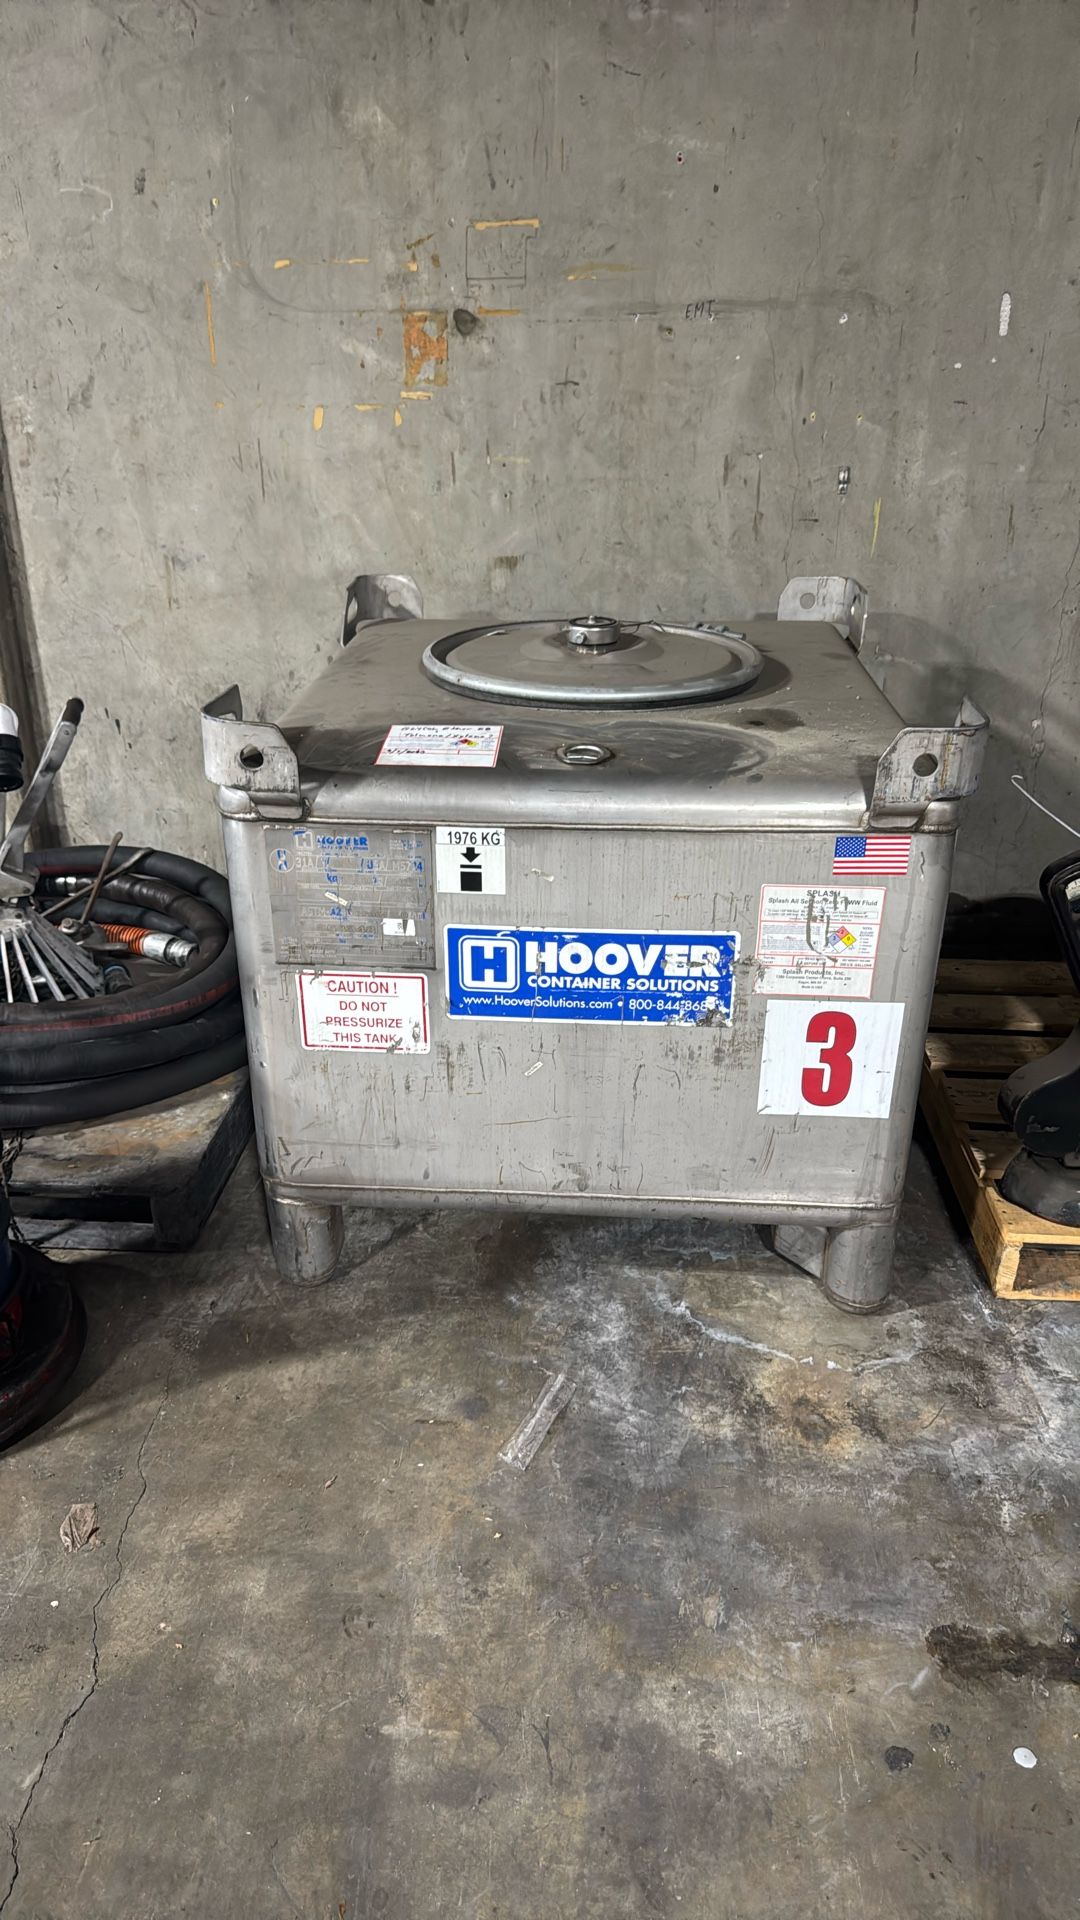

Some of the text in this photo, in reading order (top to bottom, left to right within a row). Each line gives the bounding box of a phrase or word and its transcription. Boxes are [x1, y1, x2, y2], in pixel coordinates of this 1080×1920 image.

[448, 831, 500, 846] 1976 KG
[768, 897, 788, 905] Splash
[525, 941, 721, 977] HOOVER
[327, 980, 389, 994] CAUTION
[527, 975, 719, 992] CONTAINER SOLUTIONS
[339, 1001, 388, 1012] DO NOT
[463, 995, 613, 1009] www.HooverSolutions.com
[325, 1016, 403, 1028] PRESSURIZE
[333, 1032, 398, 1043] THIS TANK
[801, 1011, 857, 1107] 3
